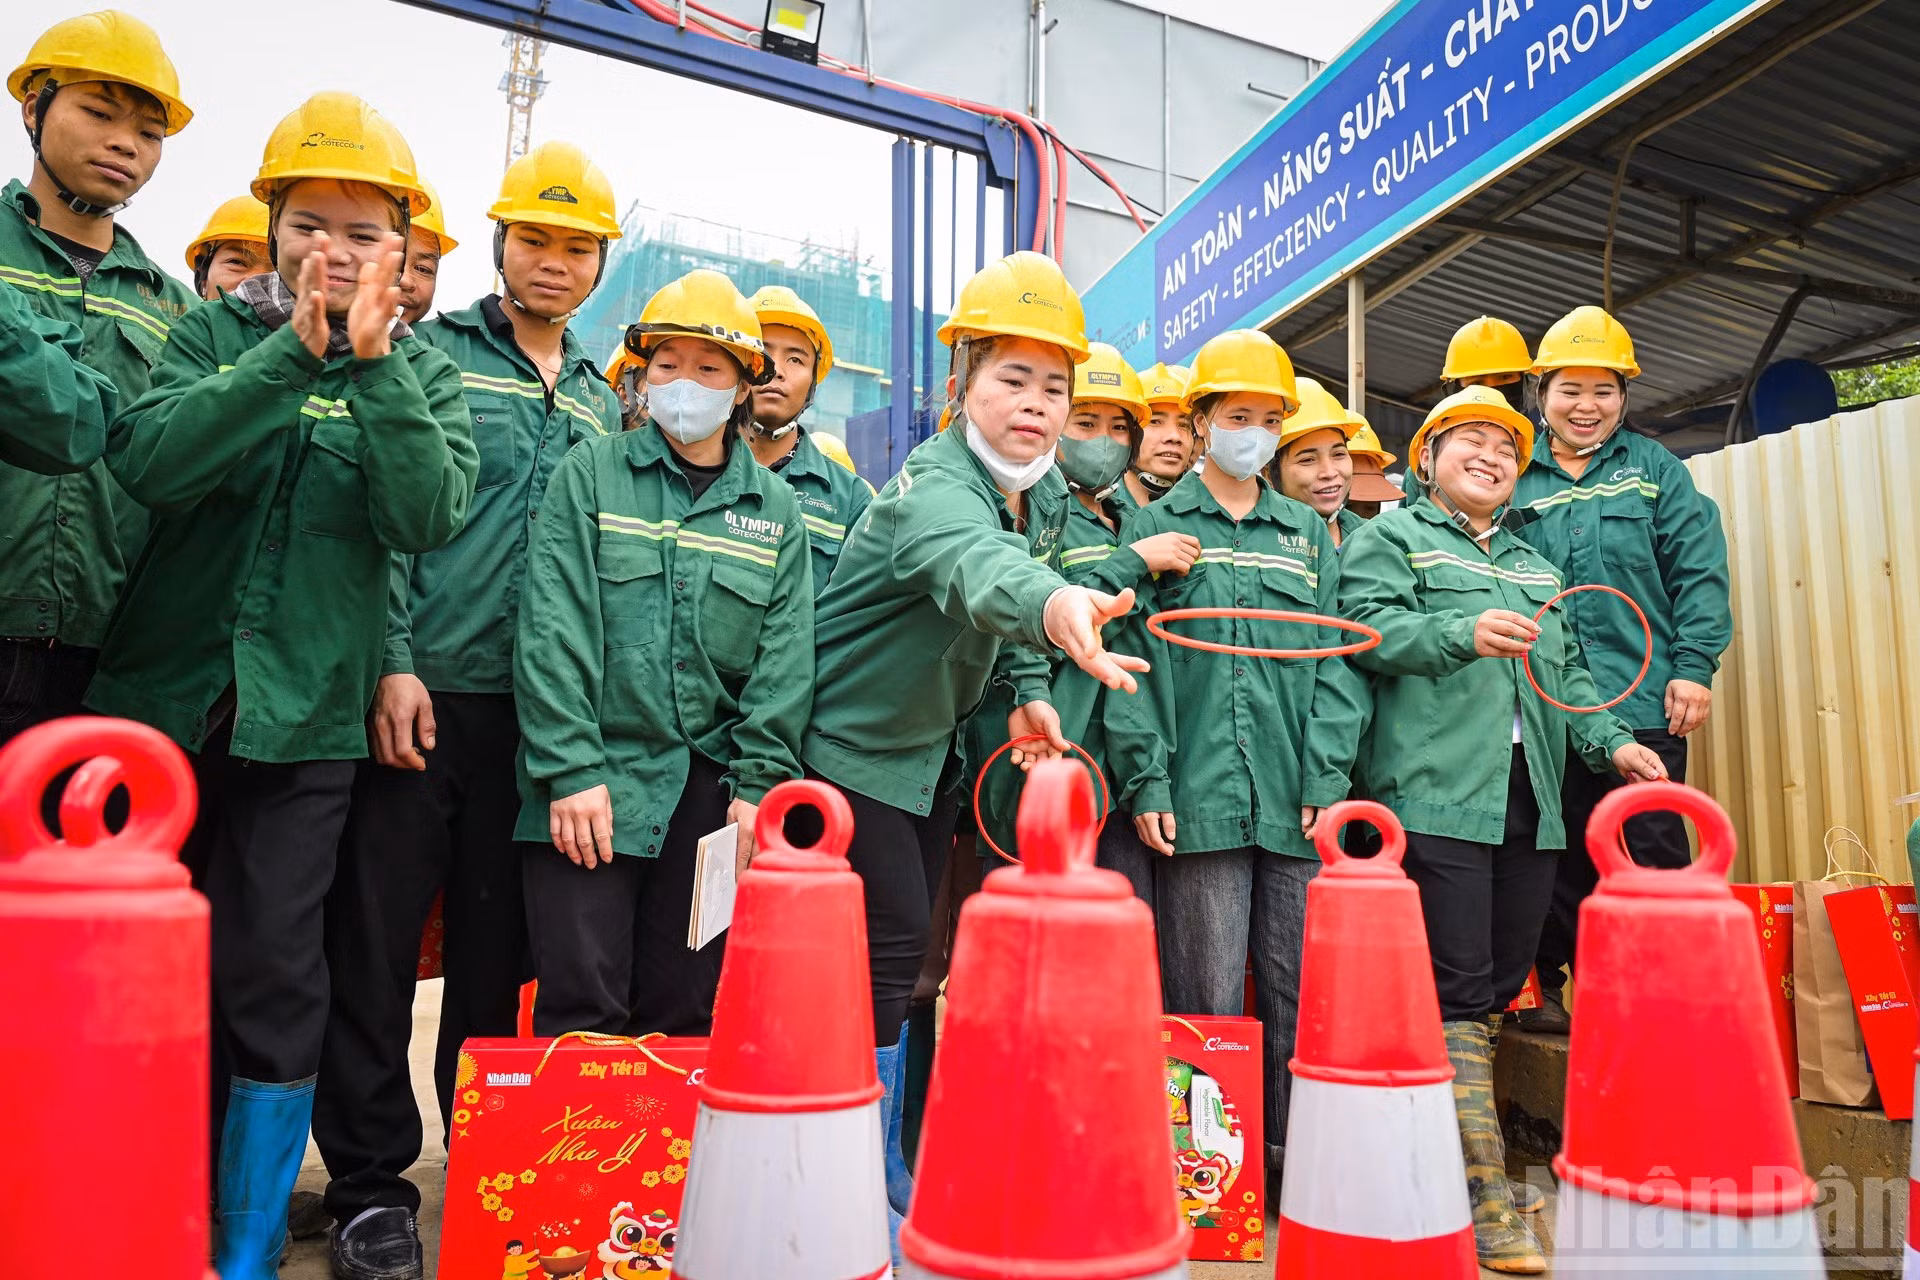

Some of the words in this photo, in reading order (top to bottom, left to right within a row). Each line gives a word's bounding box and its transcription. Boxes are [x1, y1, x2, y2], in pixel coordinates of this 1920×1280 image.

[1163, 283, 1218, 350] SAFETY
[1233, 182, 1351, 300] EFFICIENCY
[1372, 75, 1494, 196] QUALITY
[1526, 0, 1652, 90] PROD
[1163, 252, 1187, 301] AN
[1191, 203, 1243, 275] TOÀN
[1263, 131, 1331, 218] NĂNG
[1339, 57, 1411, 155] SUẤT
[724, 510, 785, 537] OLYMPIA
[578, 1061, 609, 1080] Xây
[1203, 1087, 1212, 1119] Vegetable
[541, 1104, 624, 1135] Xuân
[1204, 1118, 1212, 1137] Flavor
[597, 1127, 649, 1174] Ý
